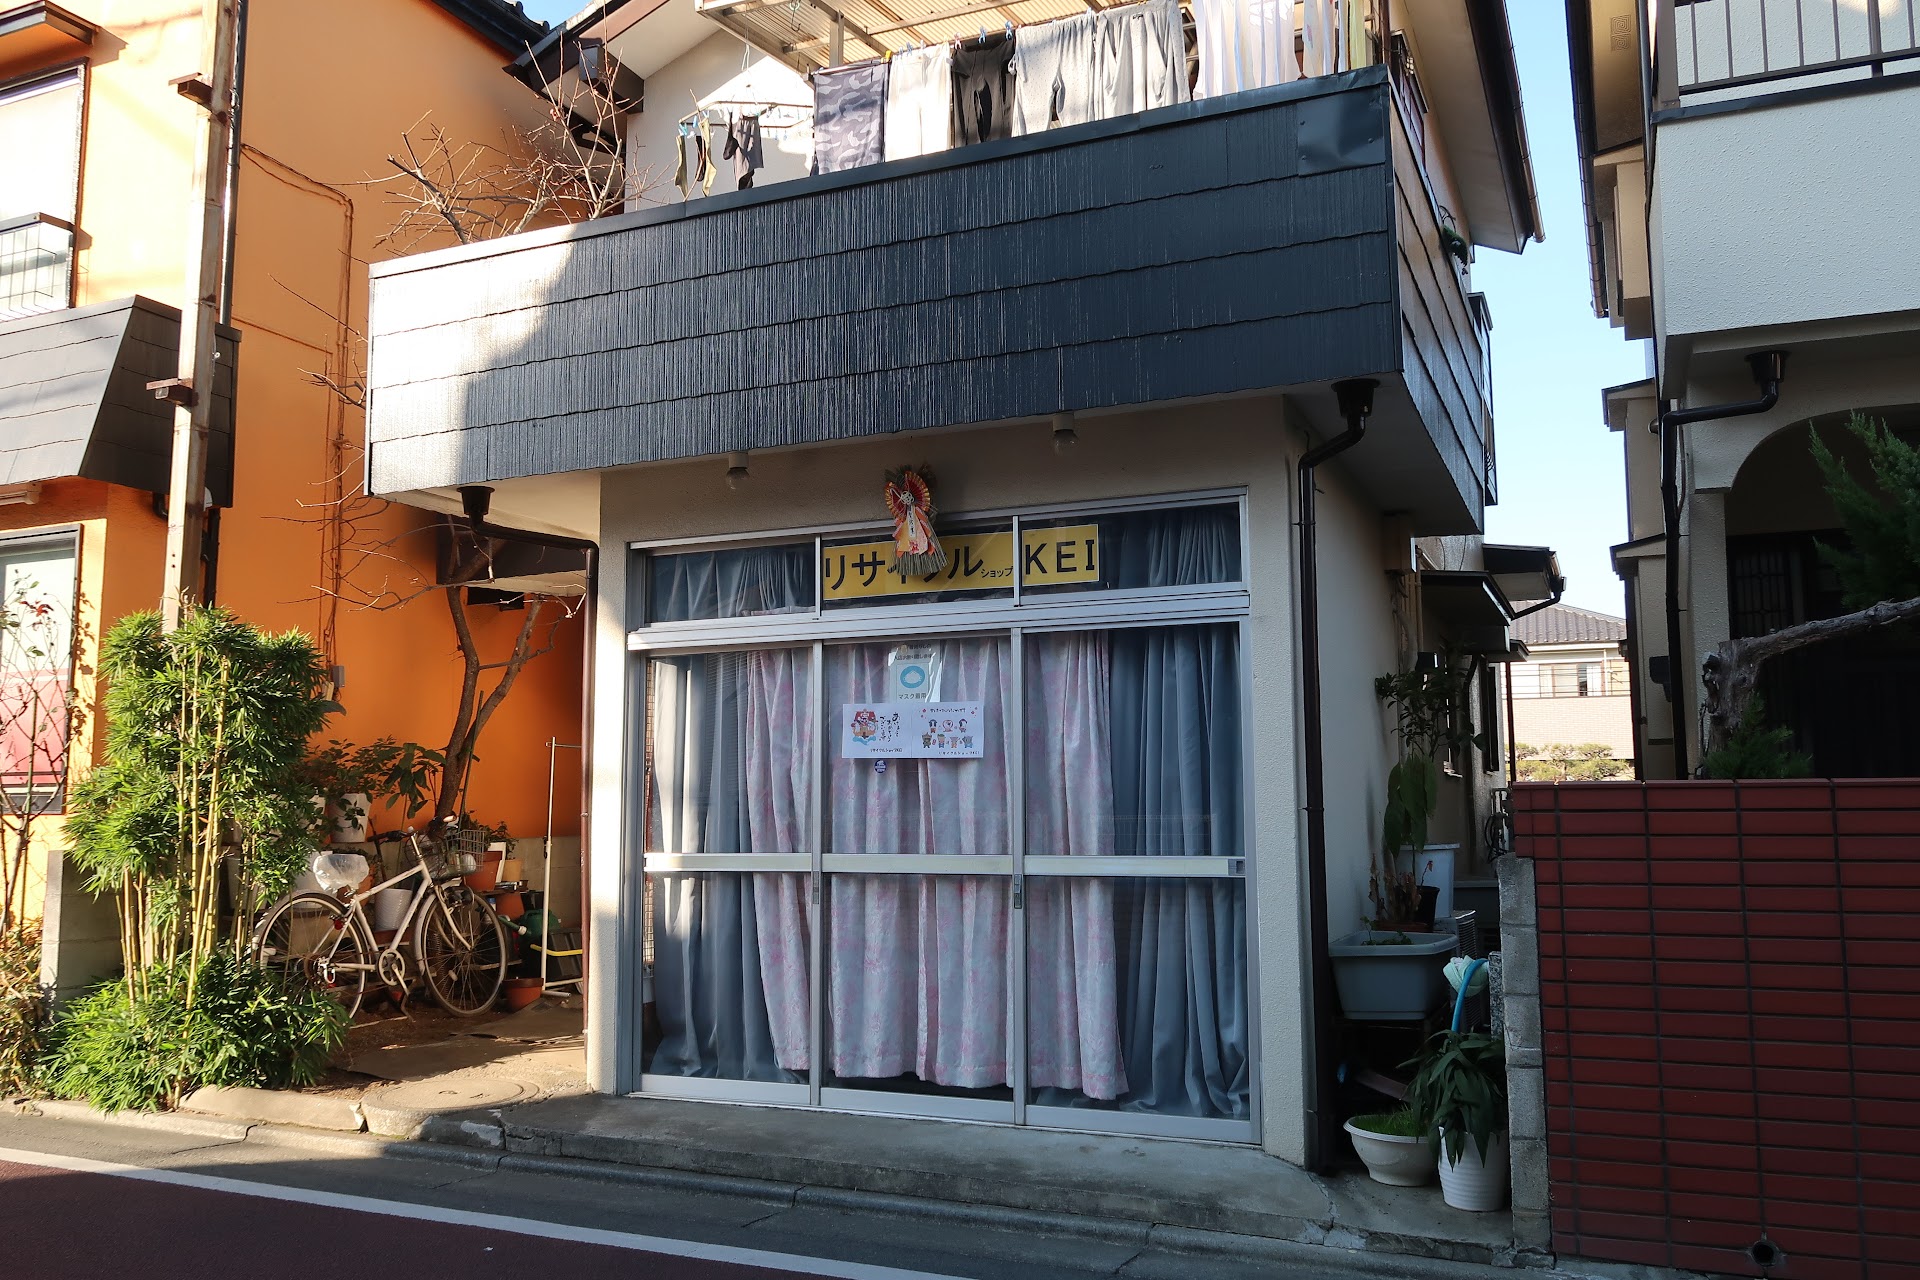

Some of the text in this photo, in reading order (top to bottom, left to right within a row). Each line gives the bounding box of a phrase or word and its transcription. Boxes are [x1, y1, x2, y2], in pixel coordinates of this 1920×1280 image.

[825, 546, 984, 591] リサル
[1025, 538, 1096, 576] KEI
